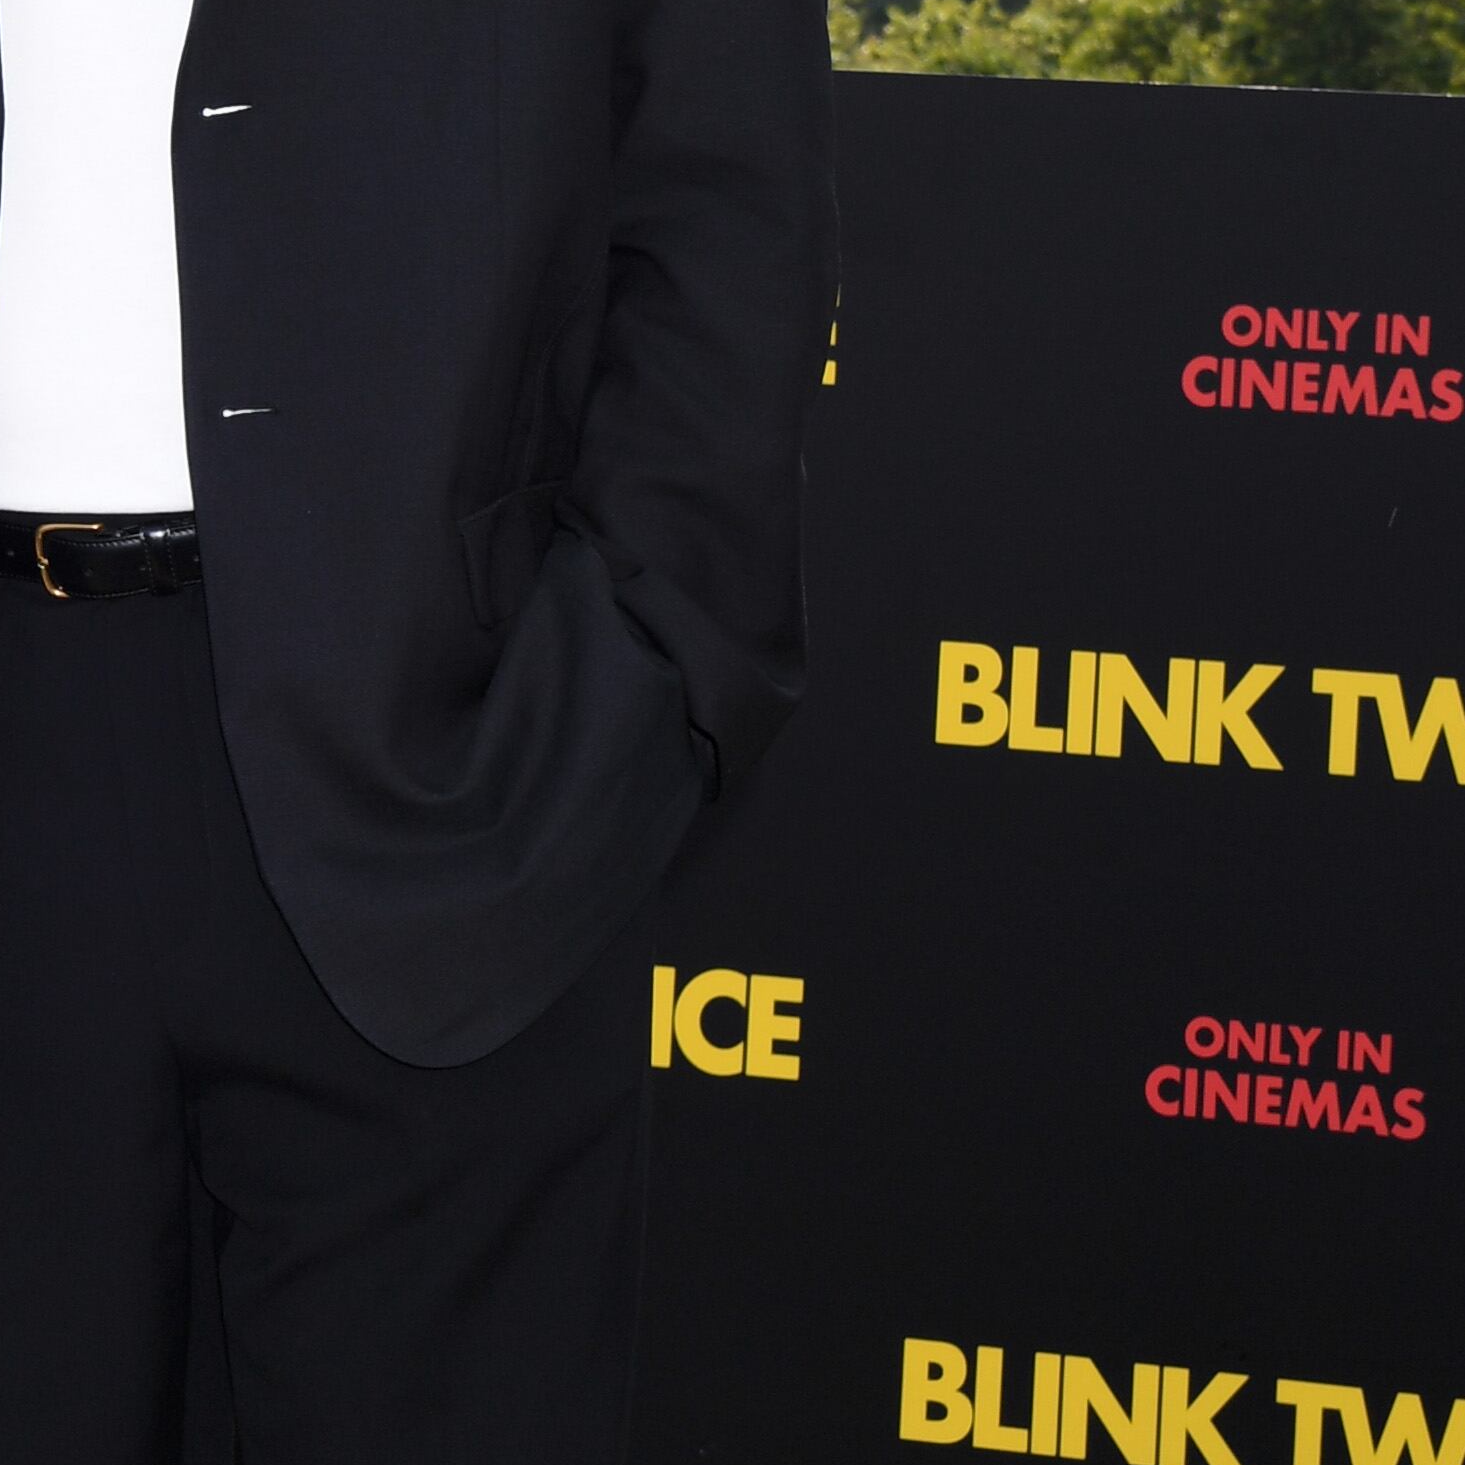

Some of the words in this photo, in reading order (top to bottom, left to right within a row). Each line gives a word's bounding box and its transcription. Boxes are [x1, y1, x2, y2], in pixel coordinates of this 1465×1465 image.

[1220, 303, 1360, 352] ONLY
[1374, 314, 1431, 357] IN
[1181, 355, 1465, 423] CINEMAS
[935, 640, 1285, 772] BLINK
[650, 965, 805, 1082] ICE
[1184, 1015, 1322, 1067] ONLY
[1337, 1029, 1393, 1075] IN
[1144, 1064, 1427, 1141] CINEMAS
